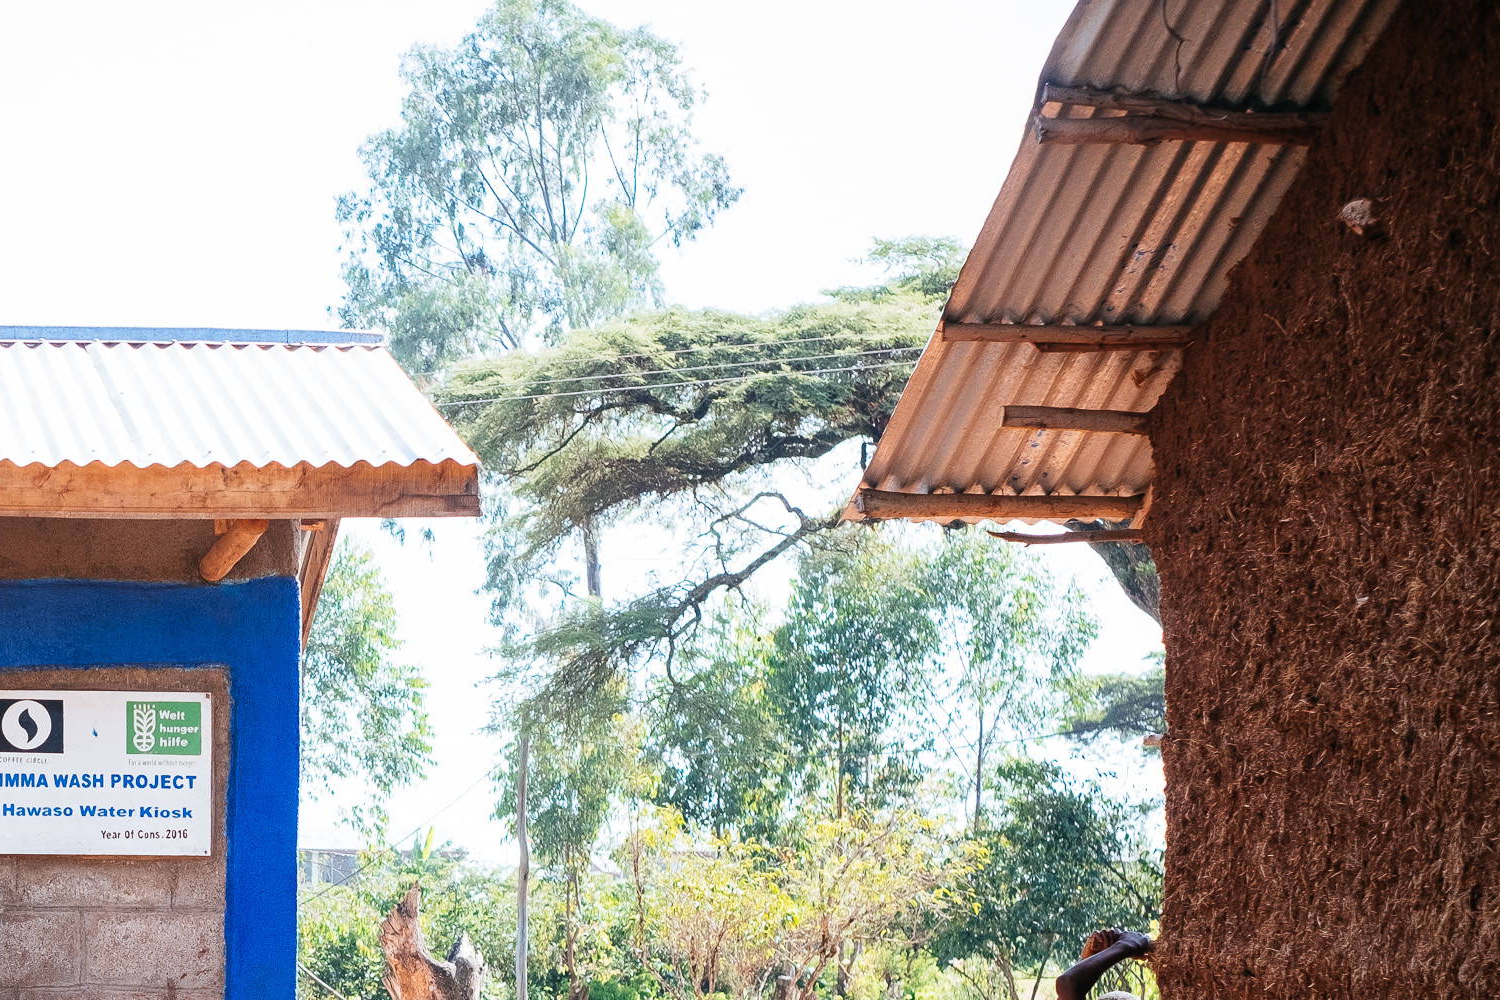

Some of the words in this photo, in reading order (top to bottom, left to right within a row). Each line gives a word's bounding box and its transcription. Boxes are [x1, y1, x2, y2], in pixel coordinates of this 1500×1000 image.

[159, 710, 185, 721] Welt
[159, 723, 199, 735] hunger
[159, 737, 188, 747] hilfe
[53, 774, 104, 788] WASH
[111, 774, 197, 789] PROJECT
[2, 803, 73, 817] Hawaso
[79, 805, 135, 818] Water
[139, 806, 193, 819] Kiosk
[100, 829, 121, 840] Year
[124, 829, 134, 839] Of
